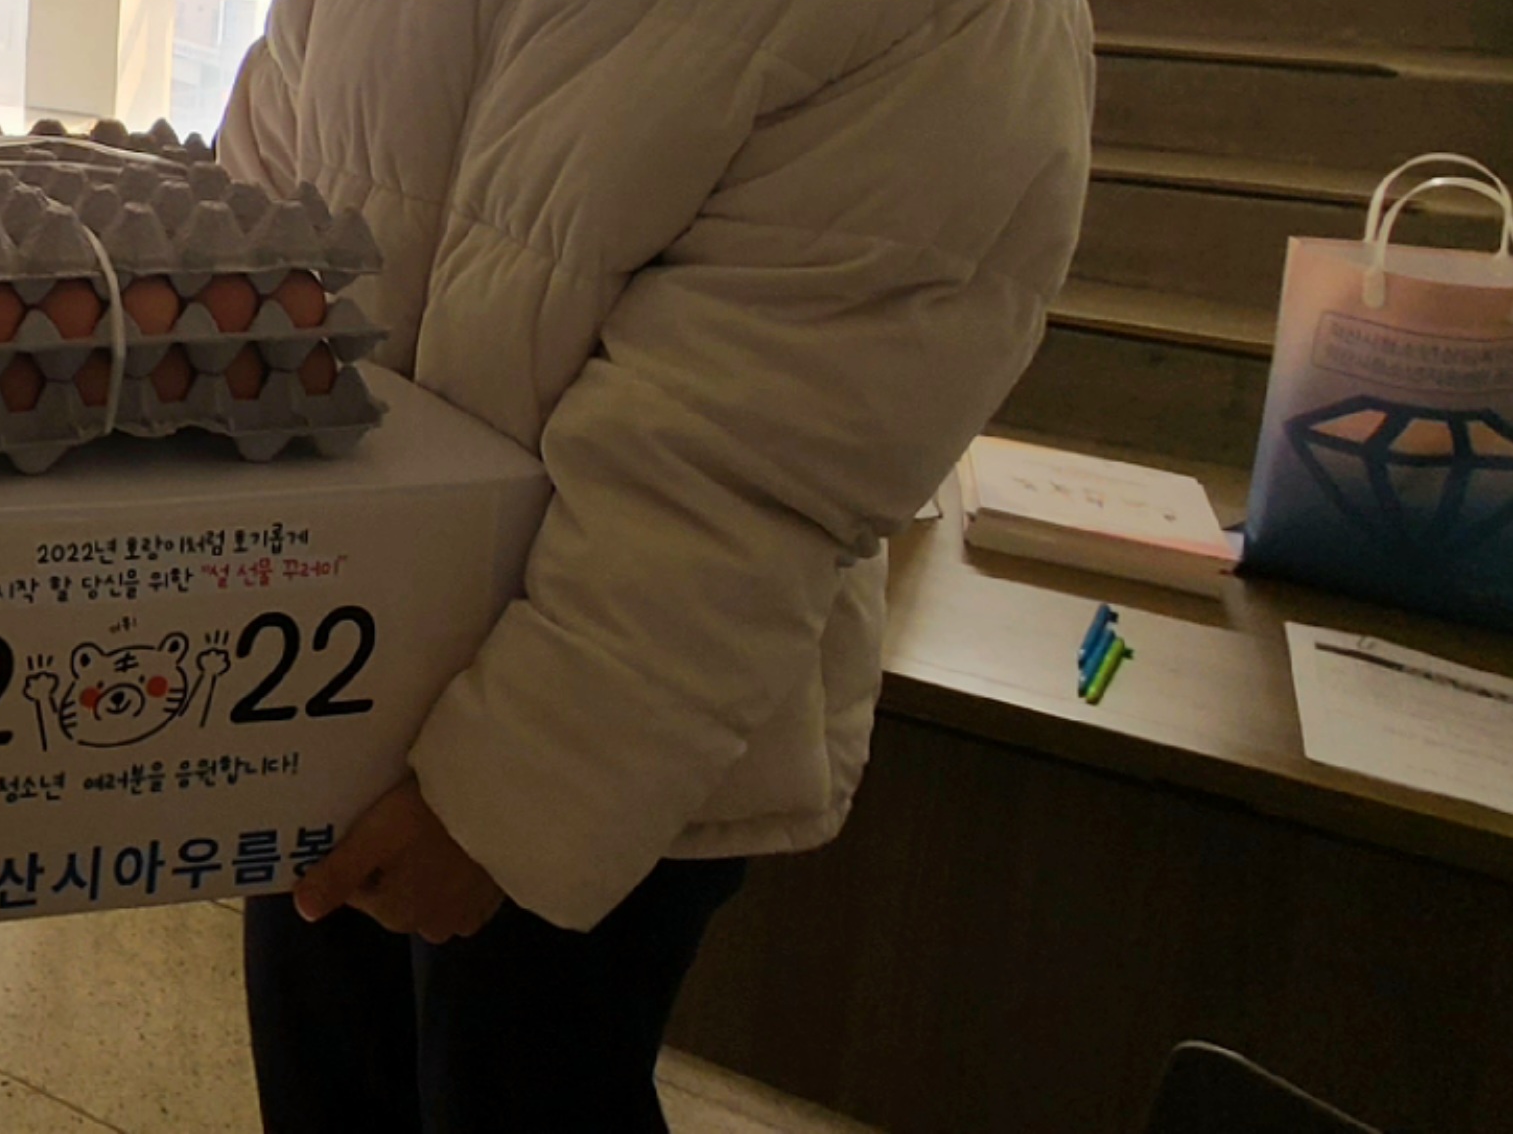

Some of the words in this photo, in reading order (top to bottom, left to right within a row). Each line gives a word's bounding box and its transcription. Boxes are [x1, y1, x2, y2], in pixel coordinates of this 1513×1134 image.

[37, 537, 117, 564] 2022년
[81, 568, 139, 600] 당신을
[148, 567, 193, 593] 위한
[237, 557, 273, 588] 선물
[83, 761, 166, 795] 여러분을
[175, 753, 300, 790] 응원합니다!
